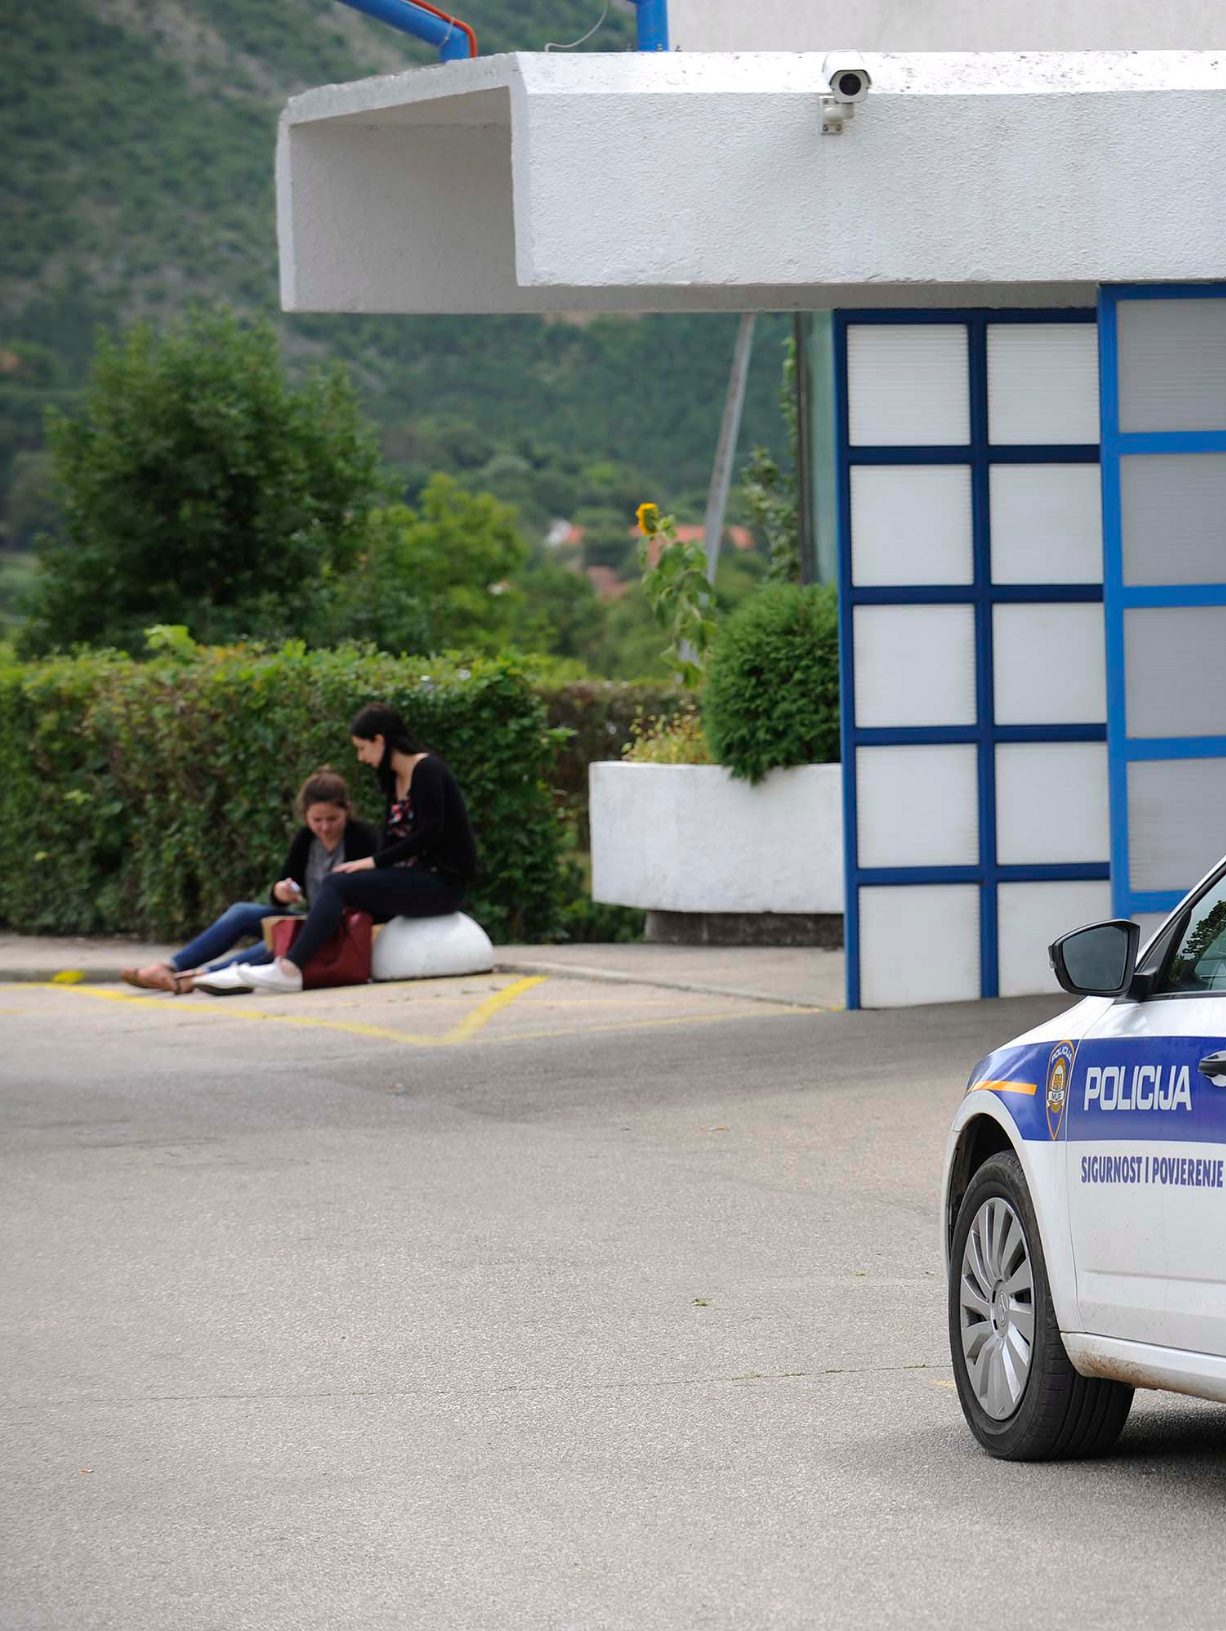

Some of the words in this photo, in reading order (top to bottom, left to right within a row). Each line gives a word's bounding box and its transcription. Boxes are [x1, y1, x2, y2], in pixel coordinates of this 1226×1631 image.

[1083, 1065, 1192, 1111] POLICIJA
[1081, 1156, 1142, 1183] SIGURNOST
[1152, 1157, 1224, 1188] POVJERENJE
